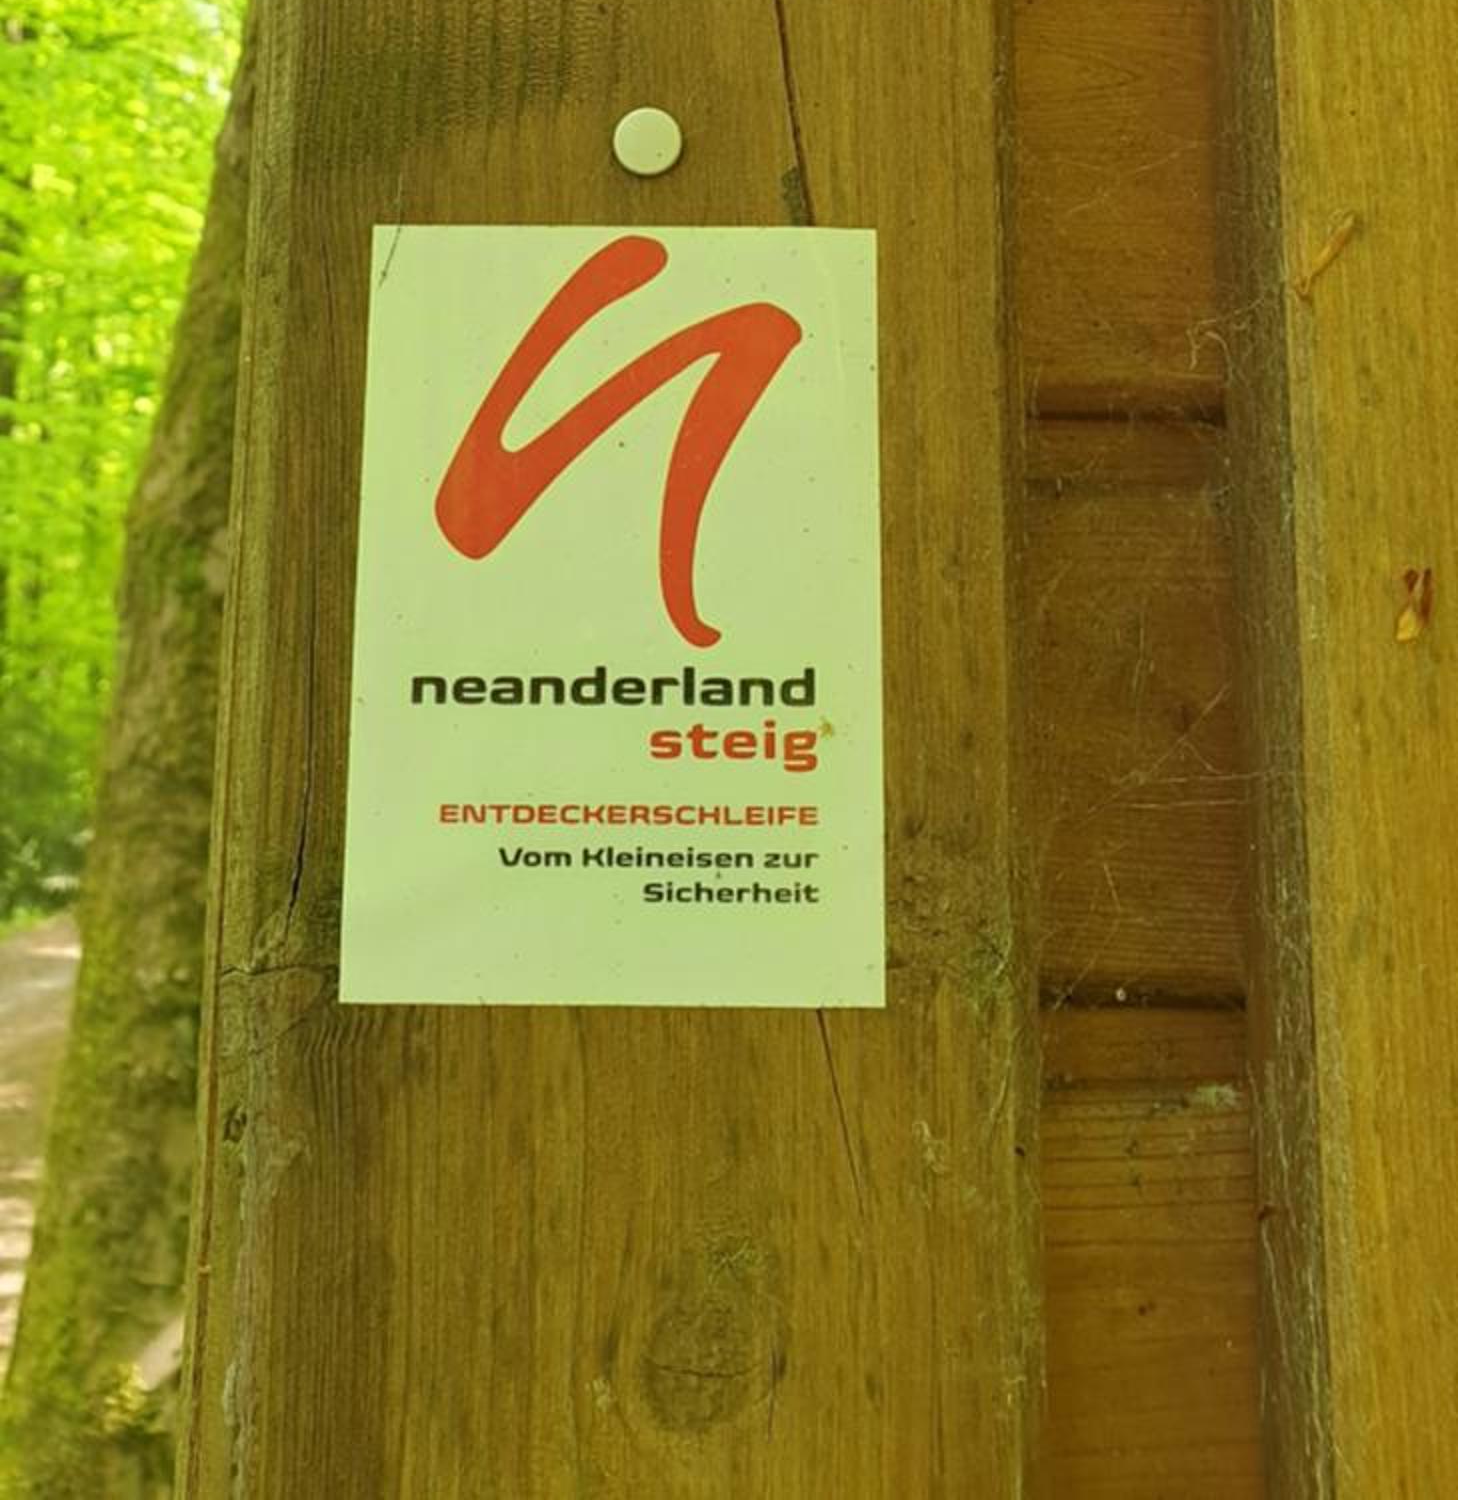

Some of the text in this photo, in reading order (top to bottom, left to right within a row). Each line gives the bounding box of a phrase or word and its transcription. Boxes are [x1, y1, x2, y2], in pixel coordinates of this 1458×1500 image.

[410, 665, 816, 707] neanderland
[648, 719, 819, 773] steig
[438, 803, 819, 827] ENTDECKERSCHLEIFE
[498, 845, 819, 869] Vom Kleineisen zur
[642, 881, 820, 904] Sicherheit
